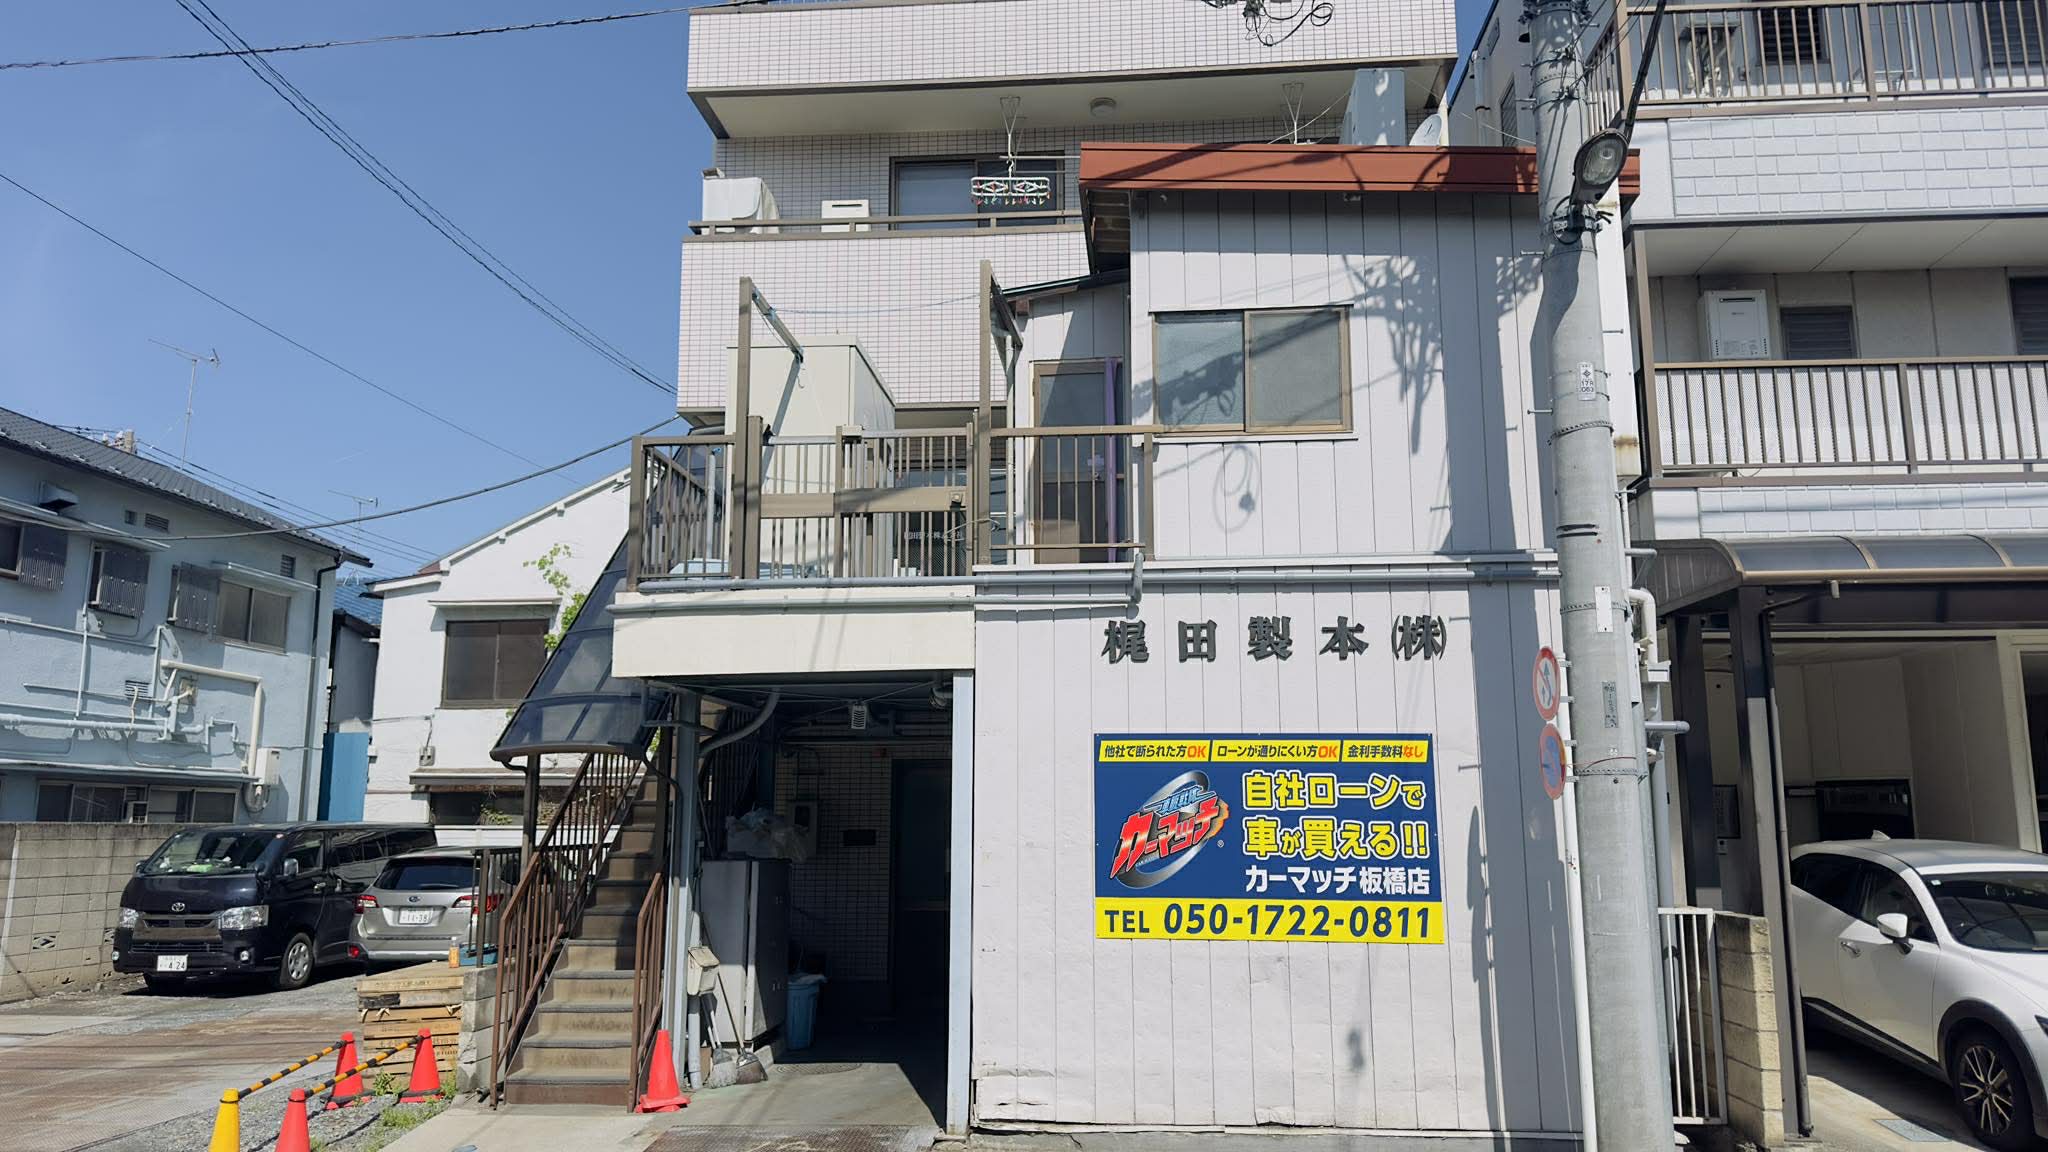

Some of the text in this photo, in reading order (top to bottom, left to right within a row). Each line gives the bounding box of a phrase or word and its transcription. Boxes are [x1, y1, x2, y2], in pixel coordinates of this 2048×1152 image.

[1105, 744, 1207, 759] 他社で断られた方OK
[1217, 744, 1338, 759] ローンが通りにくい方OK
[1347, 744, 1424, 759] 金利手数料なし
[1243, 770, 1426, 810] 自社ローンで
[1110, 796, 1219, 878] カーマッチ
[1243, 816, 1429, 860] 車が買える!!
[1245, 866, 1431, 895] カーマッチ板橋店
[1104, 902, 1430, 938] TEL 050-1722-0811
